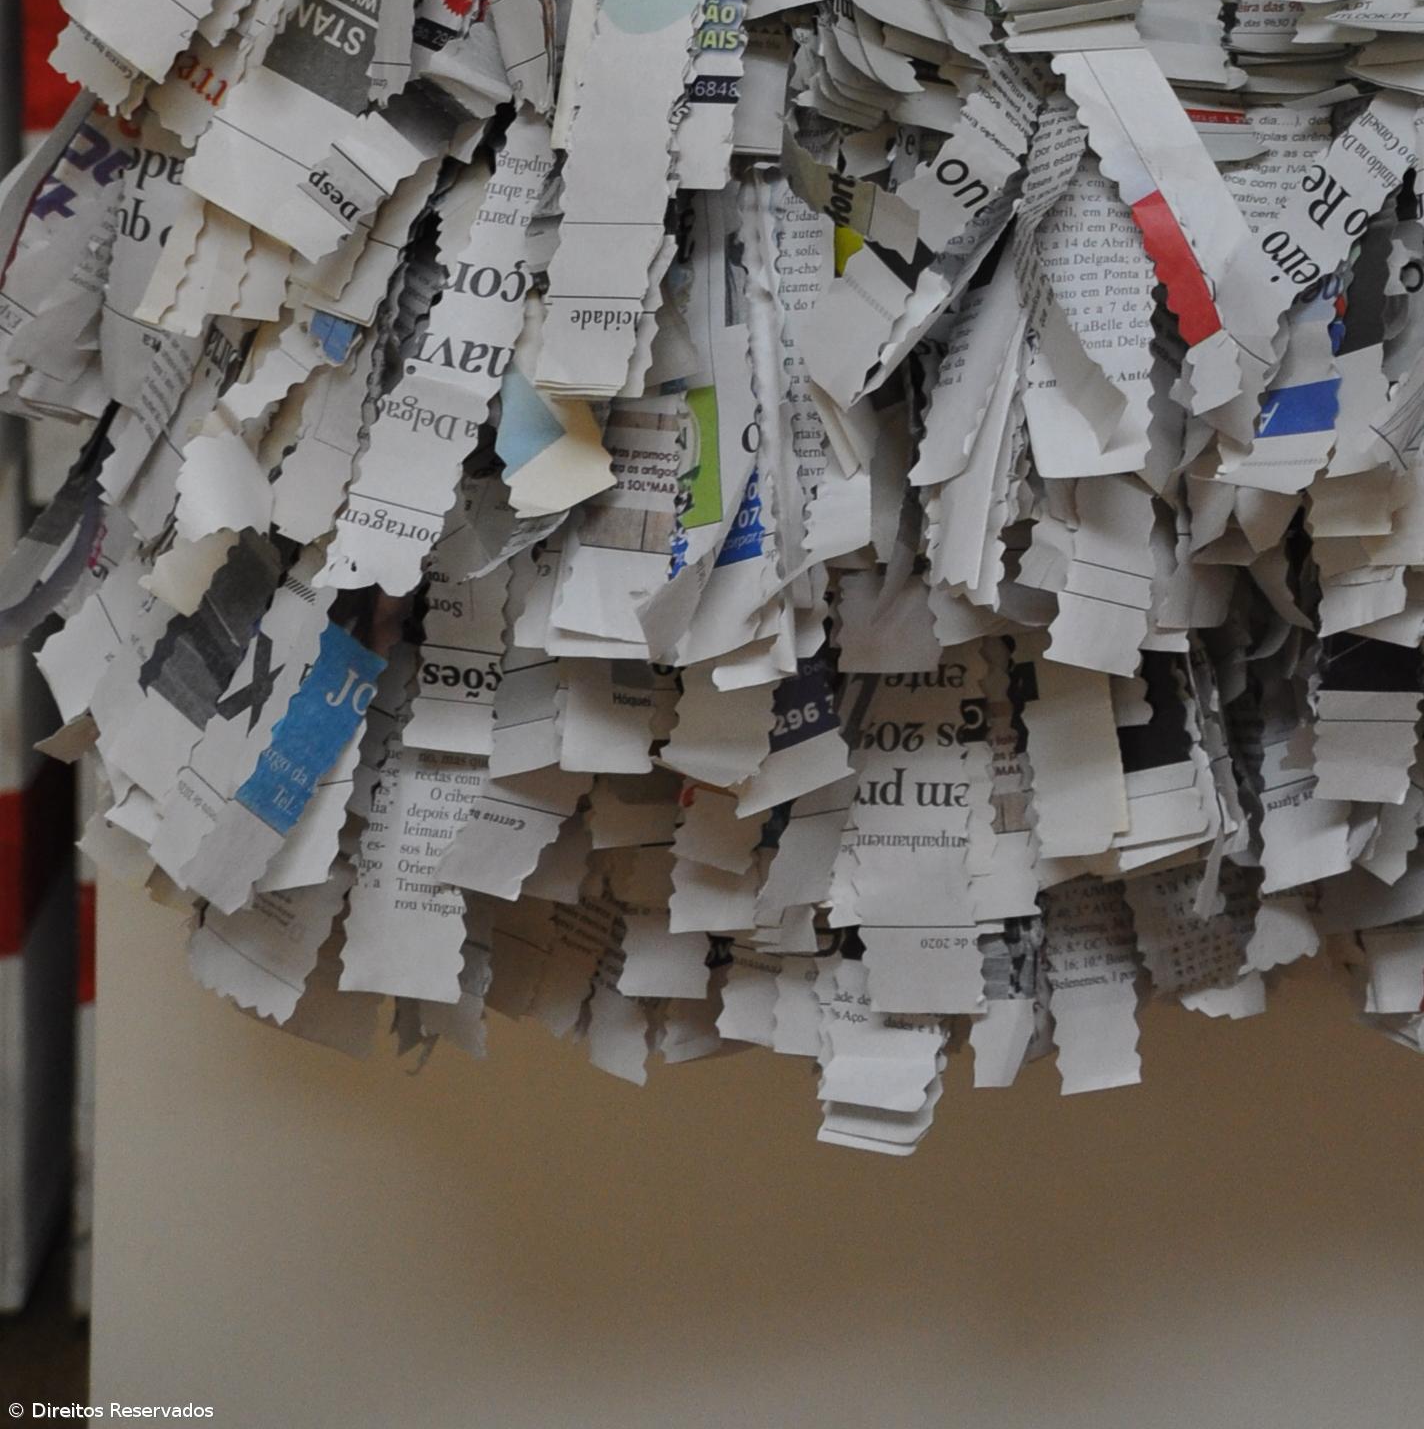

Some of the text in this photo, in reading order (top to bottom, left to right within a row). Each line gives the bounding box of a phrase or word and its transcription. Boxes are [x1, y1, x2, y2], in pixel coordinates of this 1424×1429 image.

[307, 170, 361, 221] Desp
[1104, 268, 1141, 281] Ponta
[406, 802, 450, 824] depois
[919, 936, 951, 950] 2020
